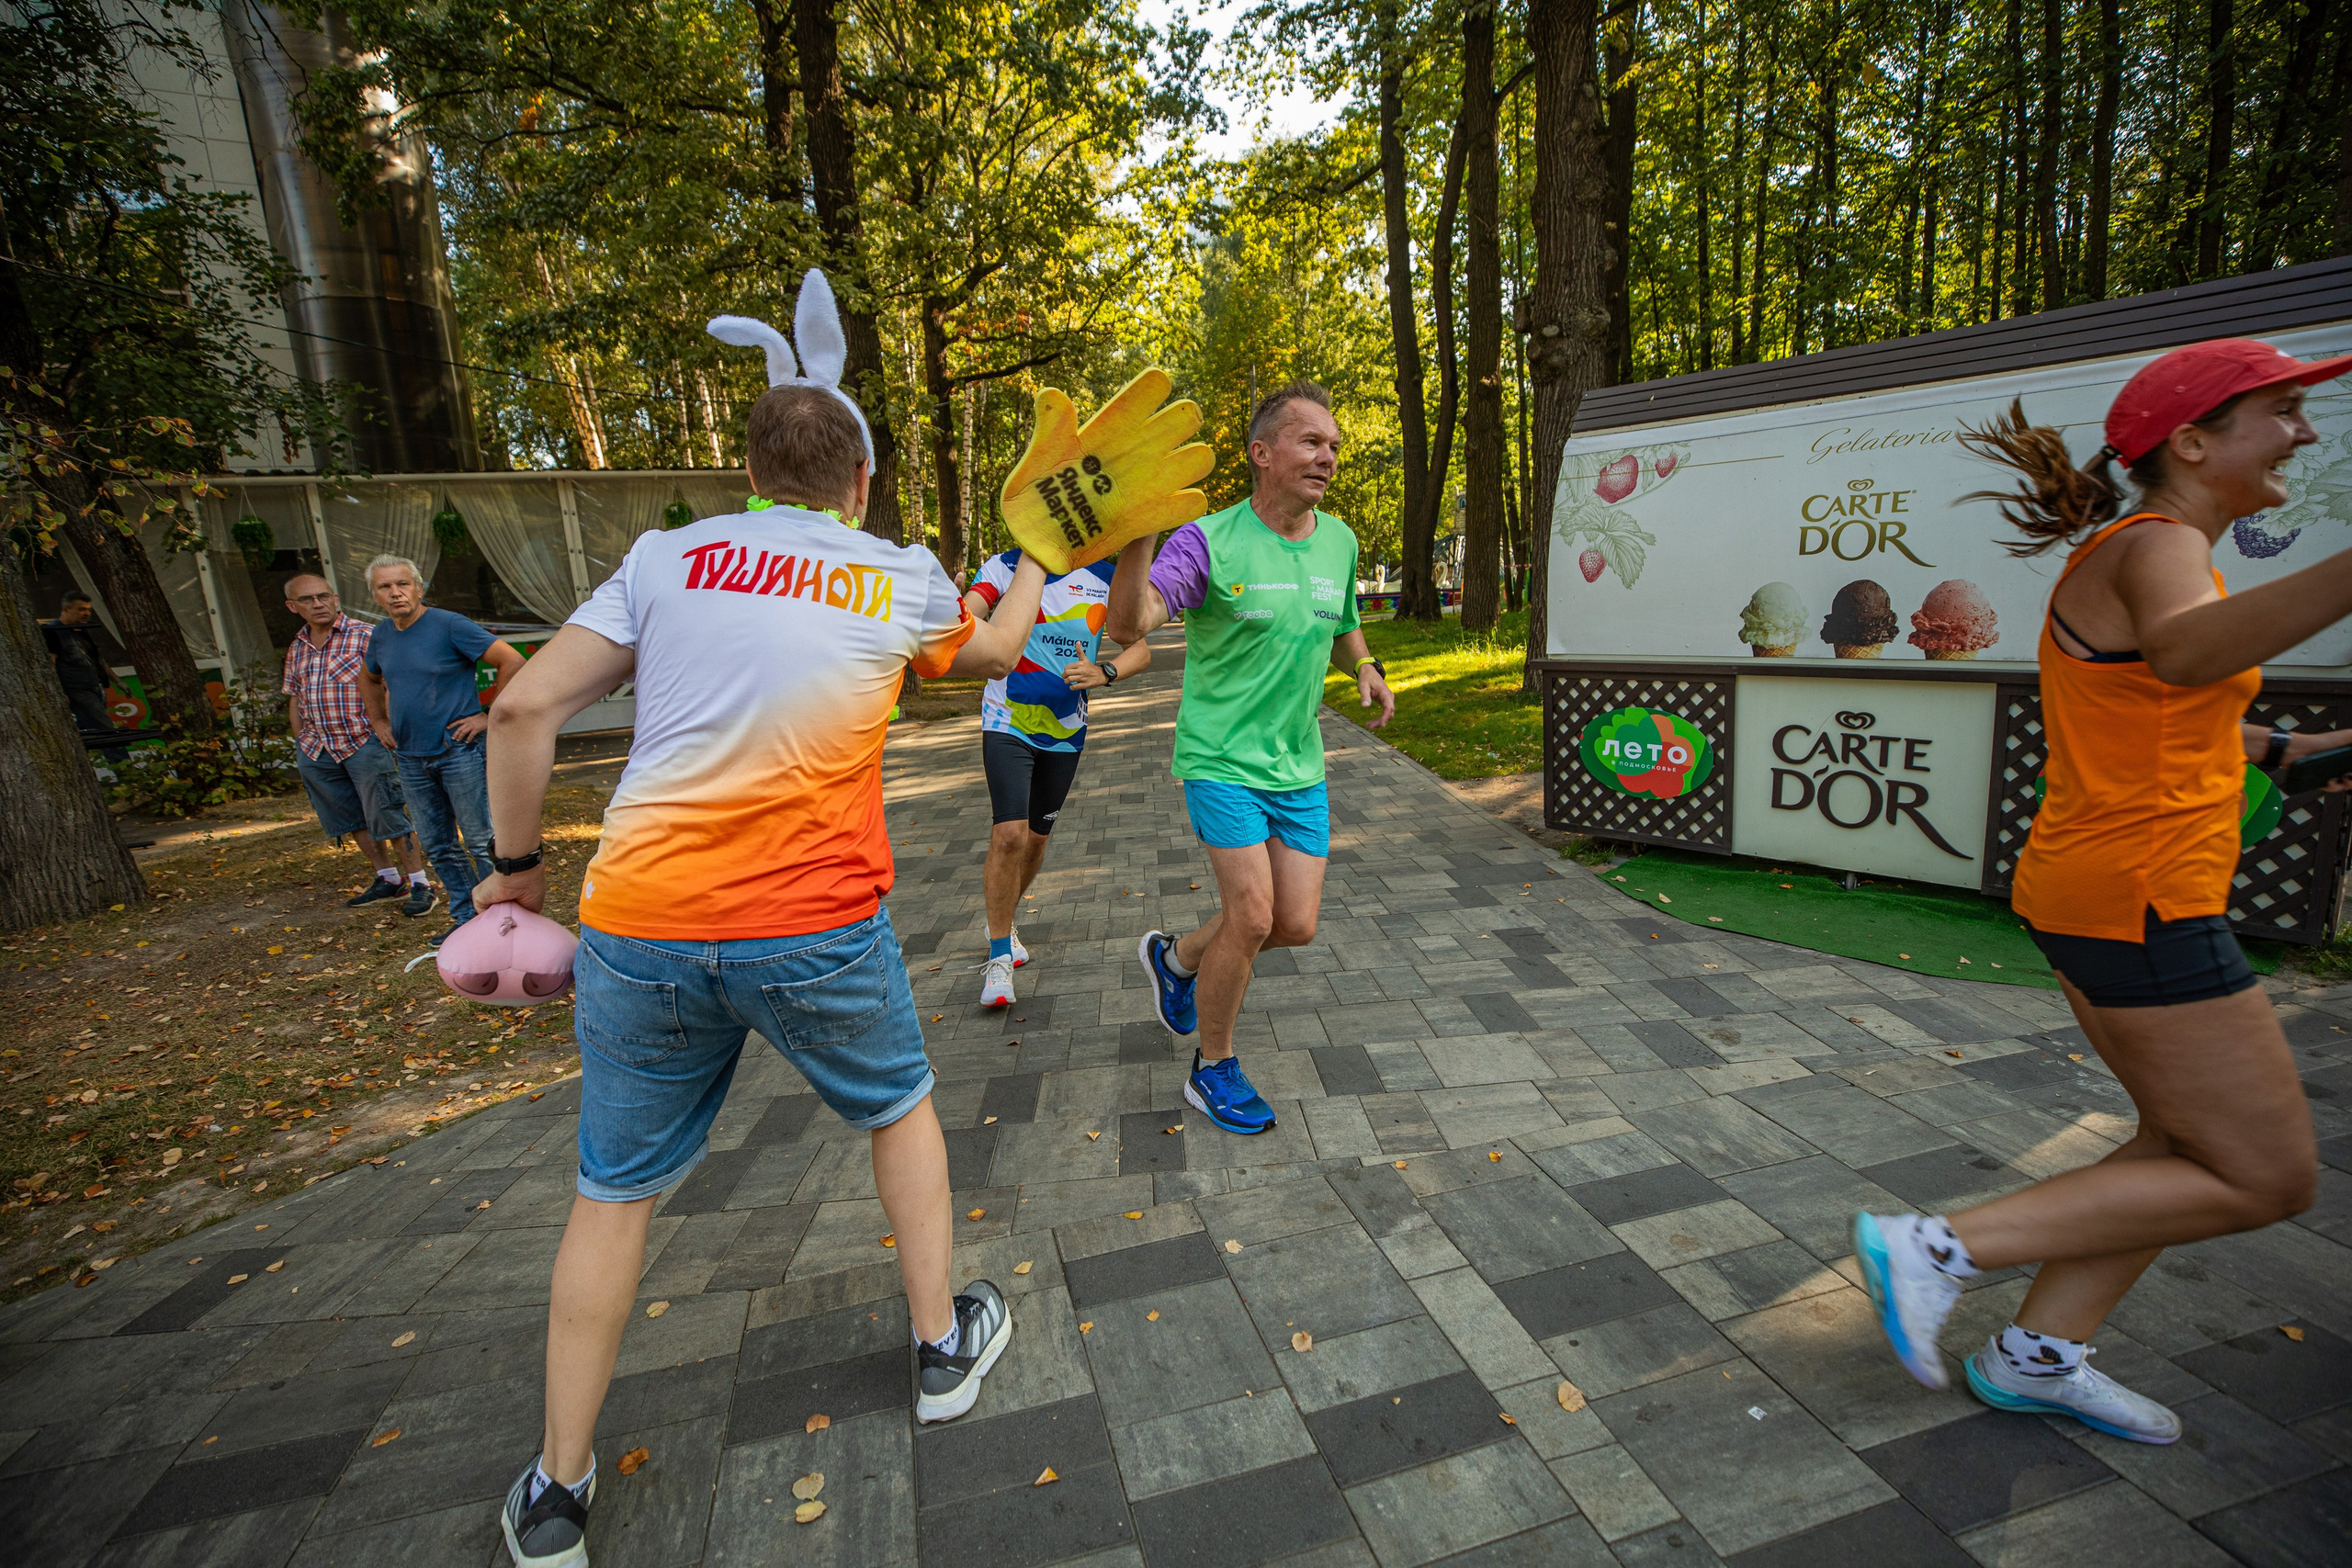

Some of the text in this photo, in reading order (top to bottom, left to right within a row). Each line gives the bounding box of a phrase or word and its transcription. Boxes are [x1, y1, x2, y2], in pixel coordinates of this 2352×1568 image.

[1806, 427, 1956, 465] Gelateria
[1035, 476, 1085, 549] Маркет
[1056, 467, 1102, 538] Яндекс
[1798, 518, 1938, 568] D'OR
[681, 540, 893, 623] ТУШИНОГИ
[1247, 582, 1299, 591] ТИНЬКОФФ
[1309, 576, 1335, 588] SPORT
[1311, 592, 1332, 602] FEST
[1313, 609, 1343, 621] VOLUN
[1055, 648, 1087, 658] 202
[1771, 724, 1933, 776] CARTE
[1770, 764, 1974, 860] D'OR
